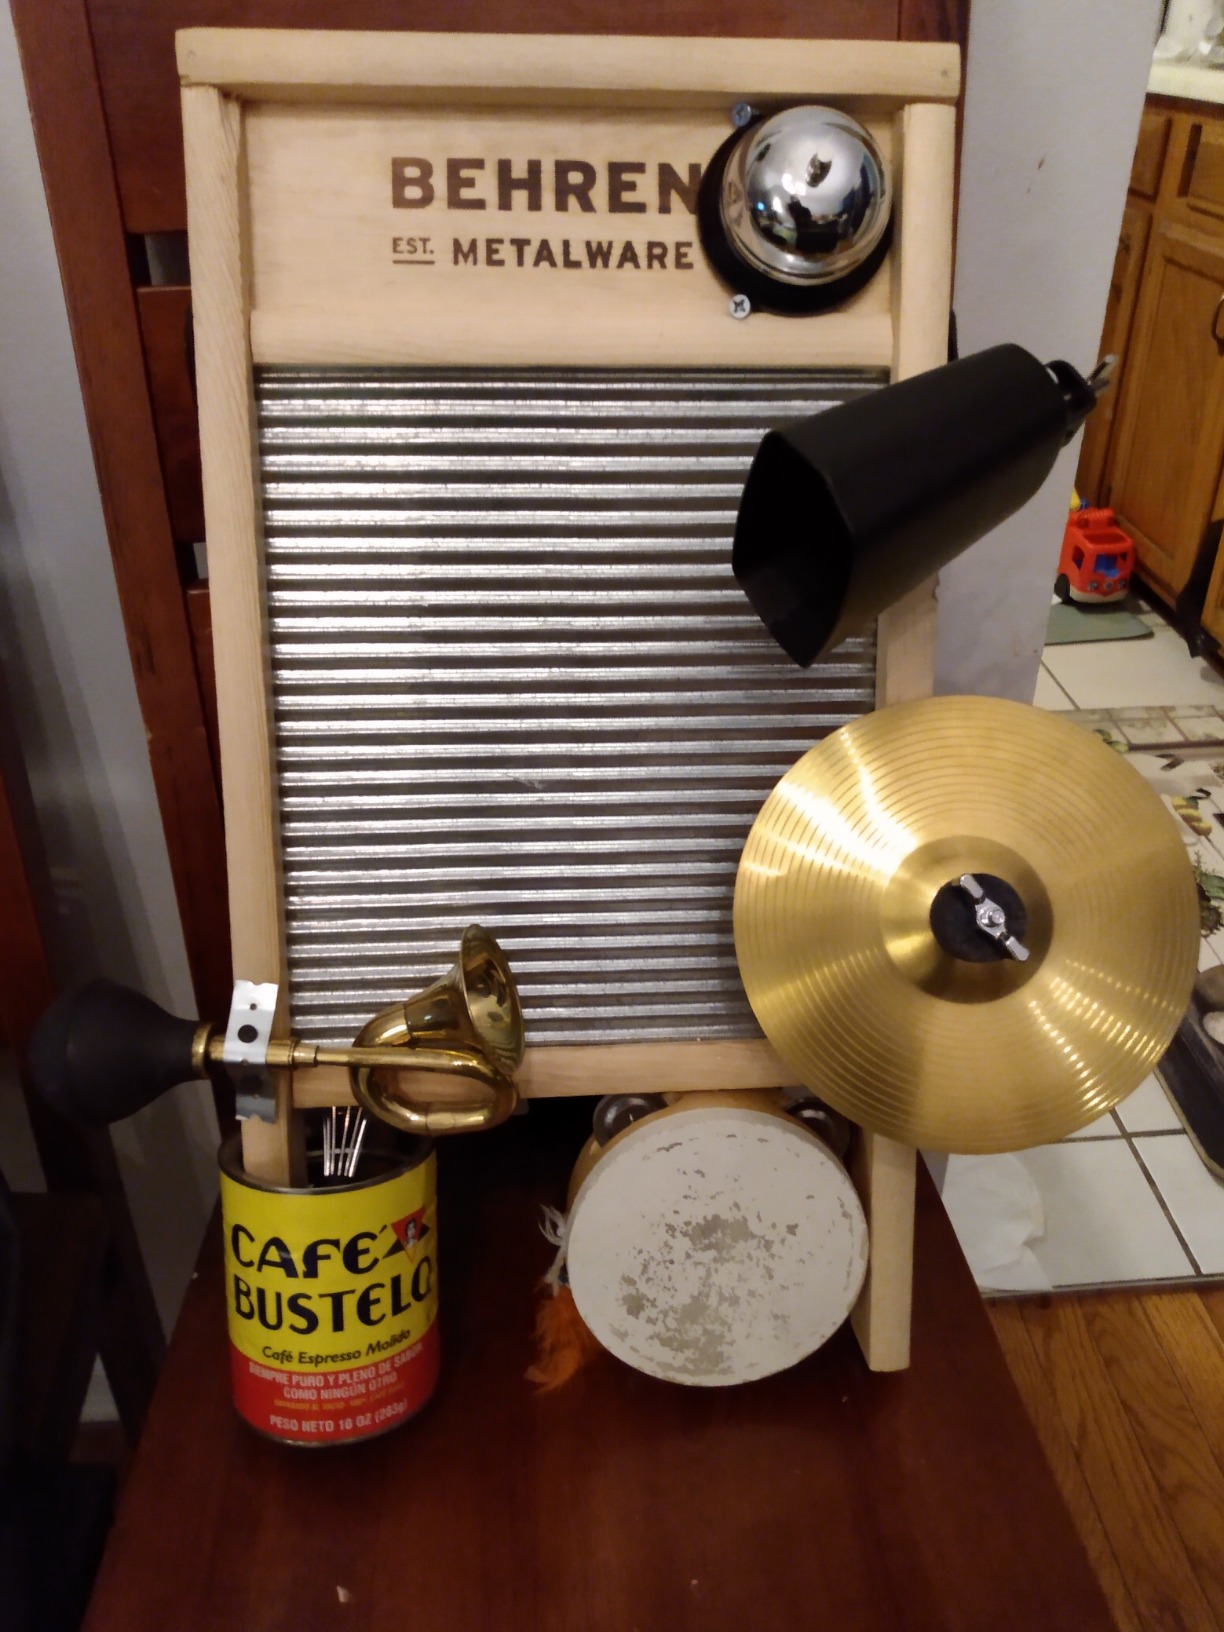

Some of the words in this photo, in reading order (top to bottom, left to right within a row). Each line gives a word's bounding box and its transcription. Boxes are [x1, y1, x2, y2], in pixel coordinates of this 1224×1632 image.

[391, 157, 702, 214] BEHREN
[392, 237, 434, 255] EST.
[452, 238, 695, 270] METALWARE
[231, 1223, 388, 1278] CAFÉ
[233, 1255, 432, 1335] BUSTELO
[248, 1361, 290, 1385] SIEMPRE
[291, 1373, 325, 1387] PURO
[327, 1374, 336, 1386] Y
[338, 1364, 376, 1385] PLENO
[378, 1359, 392, 1375] DE
[394, 1341, 423, 1368] SABOR
[262, 1345, 293, 1365] Café
[298, 1351, 362, 1368] Espresso
[365, 1329, 411, 1356] Molido
[283, 1386, 318, 1400] COMO
[368, 1371, 398, 1391] OTRO
[270, 1414, 299, 1432] PESO
[301, 1420, 334, 1433] NETO
[338, 1418, 353, 1431] 10
[355, 1412, 373, 1428] OZ
